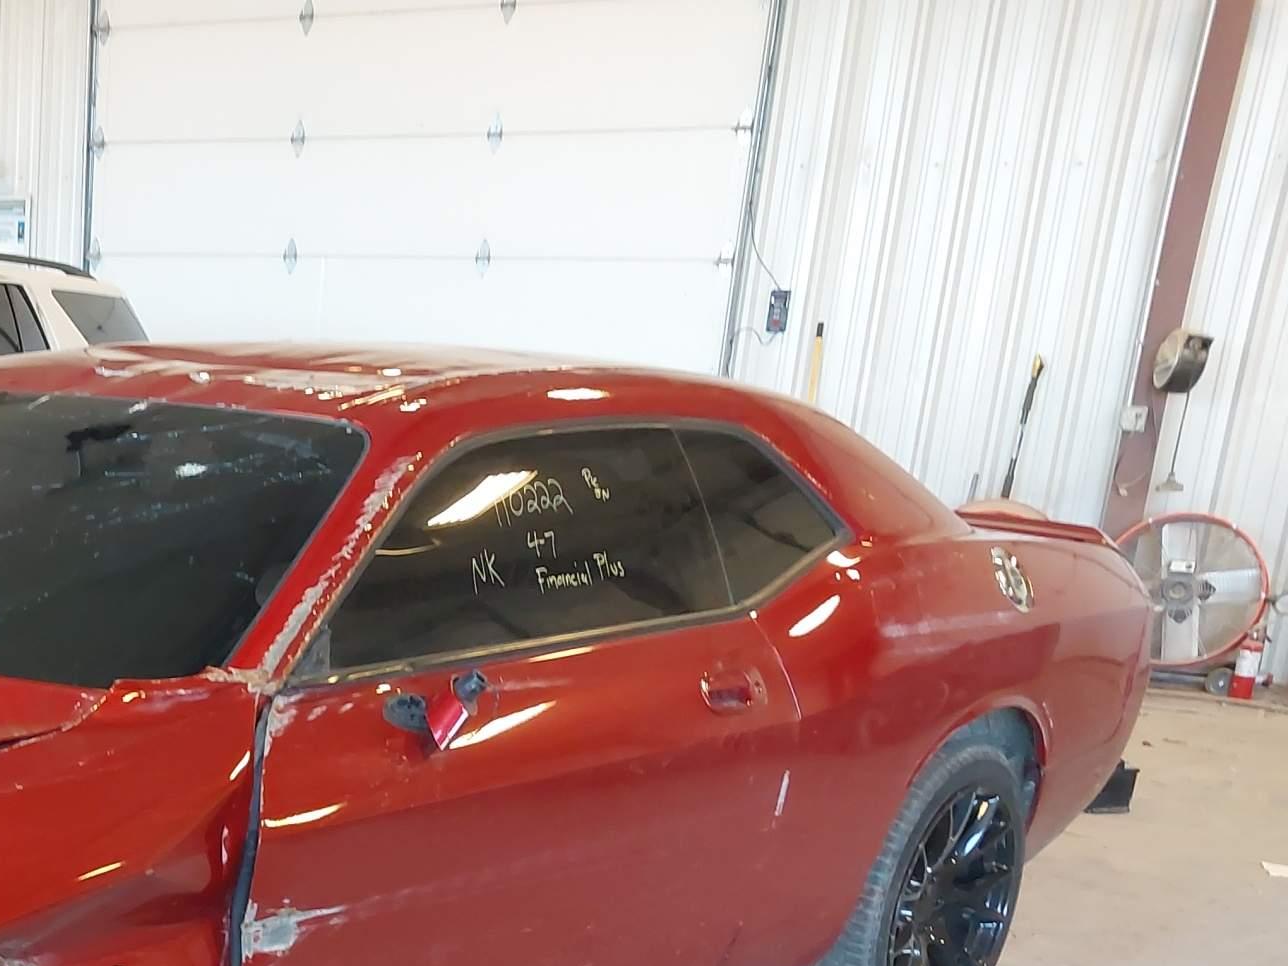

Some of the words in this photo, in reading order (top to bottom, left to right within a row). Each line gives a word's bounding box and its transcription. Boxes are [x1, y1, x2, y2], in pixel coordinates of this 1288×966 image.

[526, 530, 558, 559] 4-7
[471, 549, 505, 595] NK
[535, 560, 593, 594] Financial
[592, 550, 625, 581] Plus
